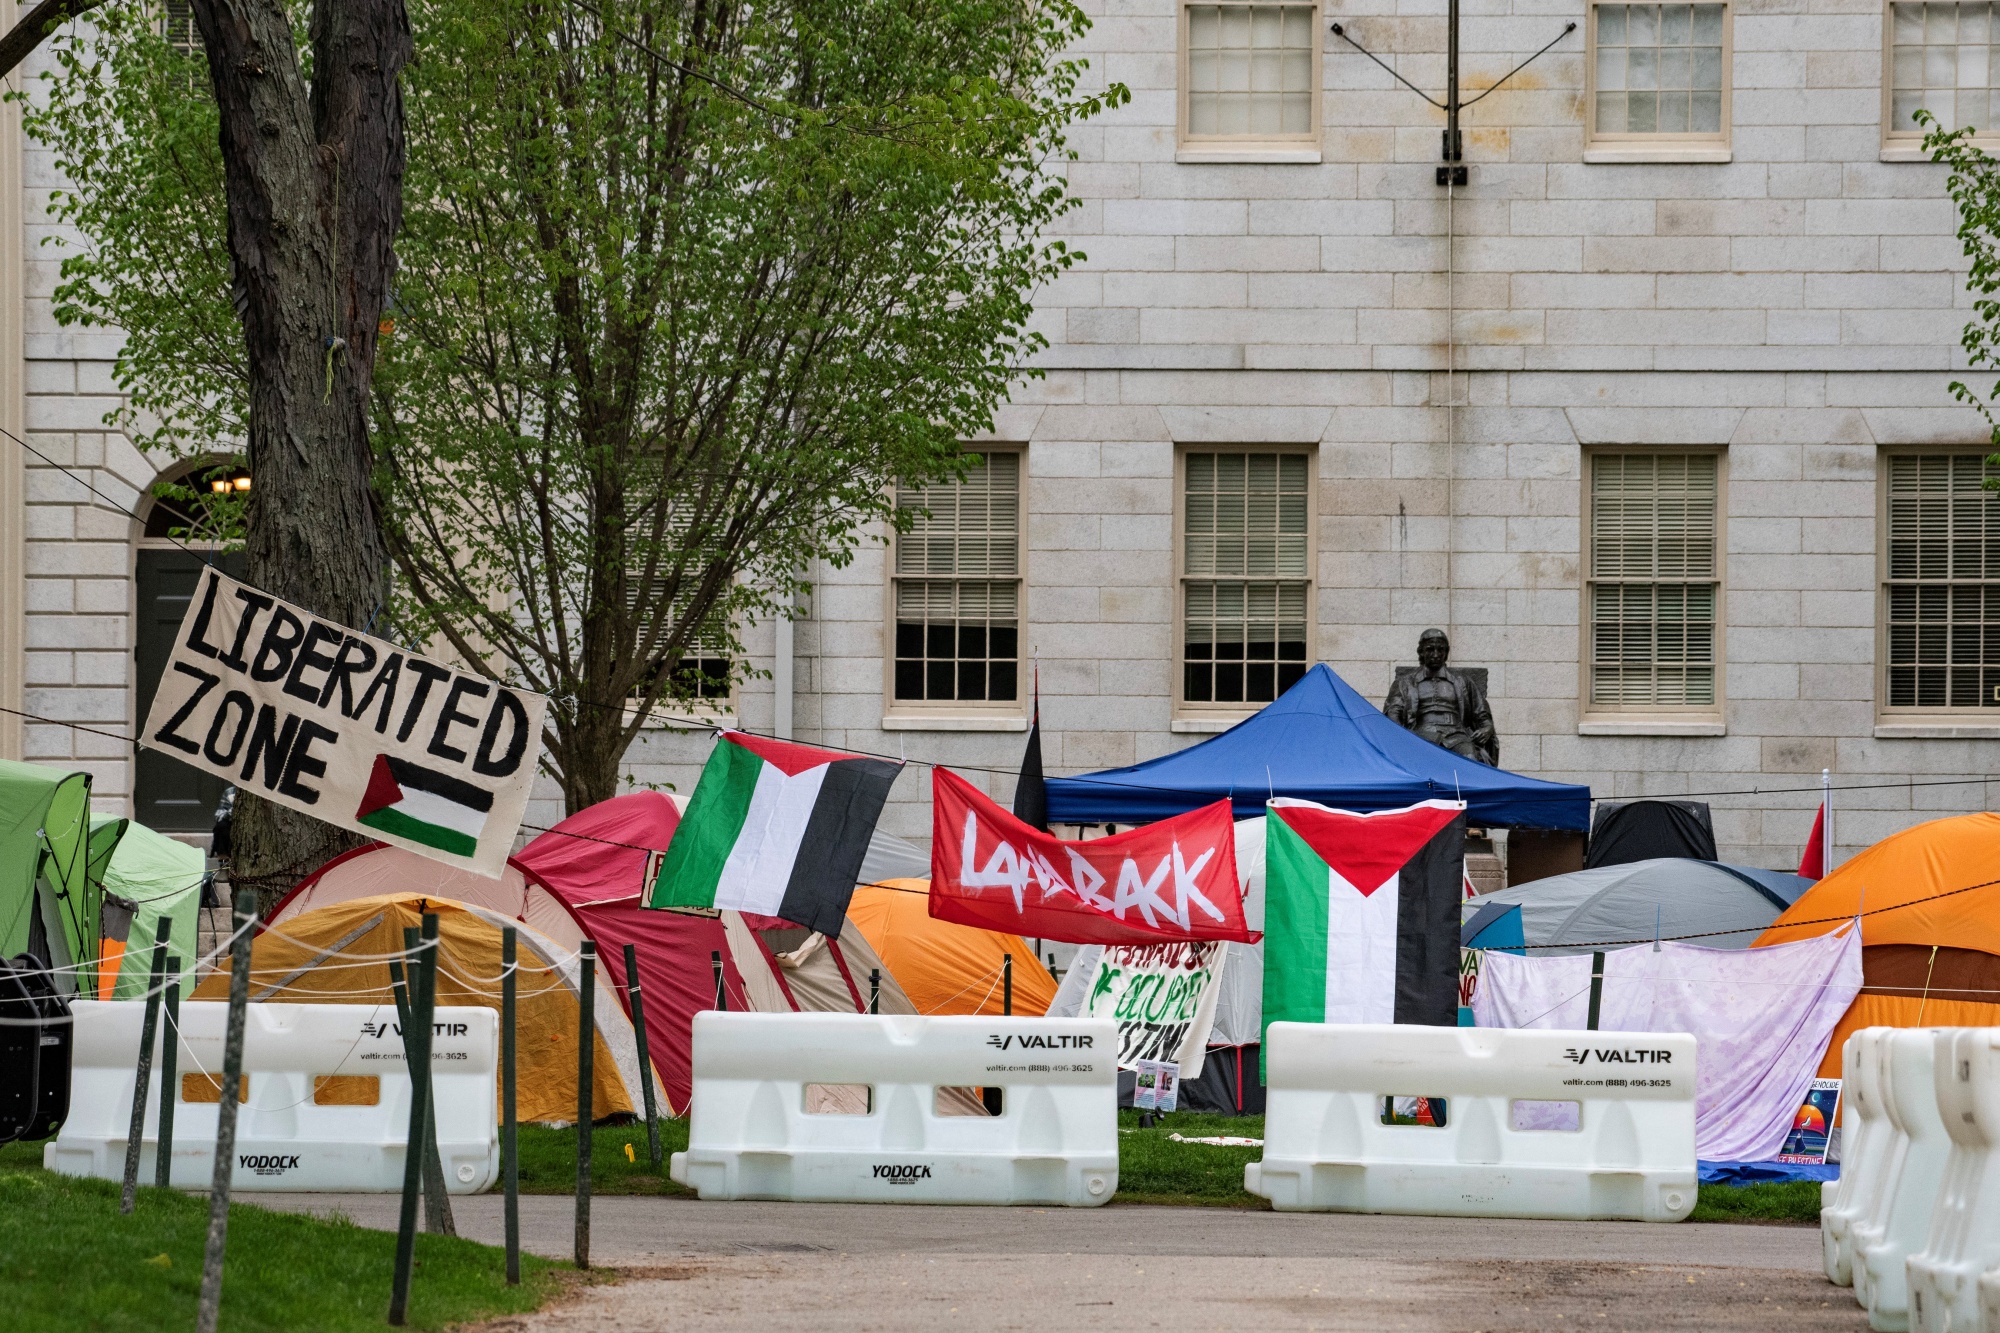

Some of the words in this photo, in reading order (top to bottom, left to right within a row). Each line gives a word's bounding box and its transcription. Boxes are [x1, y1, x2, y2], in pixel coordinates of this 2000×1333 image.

[186, 572, 529, 778] LIBERATED
[154, 660, 339, 805] ZONE
[392, 1023, 469, 1037] VTIR
[1018, 1035, 1094, 1049] VALTIR
[360, 1052, 401, 1060] valtir.com
[431, 1052, 468, 1060] 96-3625
[1594, 1049, 1673, 1064] VALTIR
[986, 1064, 1027, 1072] valtir.com
[1028, 1064, 1051, 1073] (888)
[1052, 1064, 1093, 1072] 496-3625
[1562, 1078, 1604, 1086] valtir.com
[1605, 1079, 1628, 1088] (888)
[1629, 1079, 1672, 1087] 496-3625
[239, 1155, 301, 1169] YODOCK
[872, 1164, 932, 1178] YODOCK
